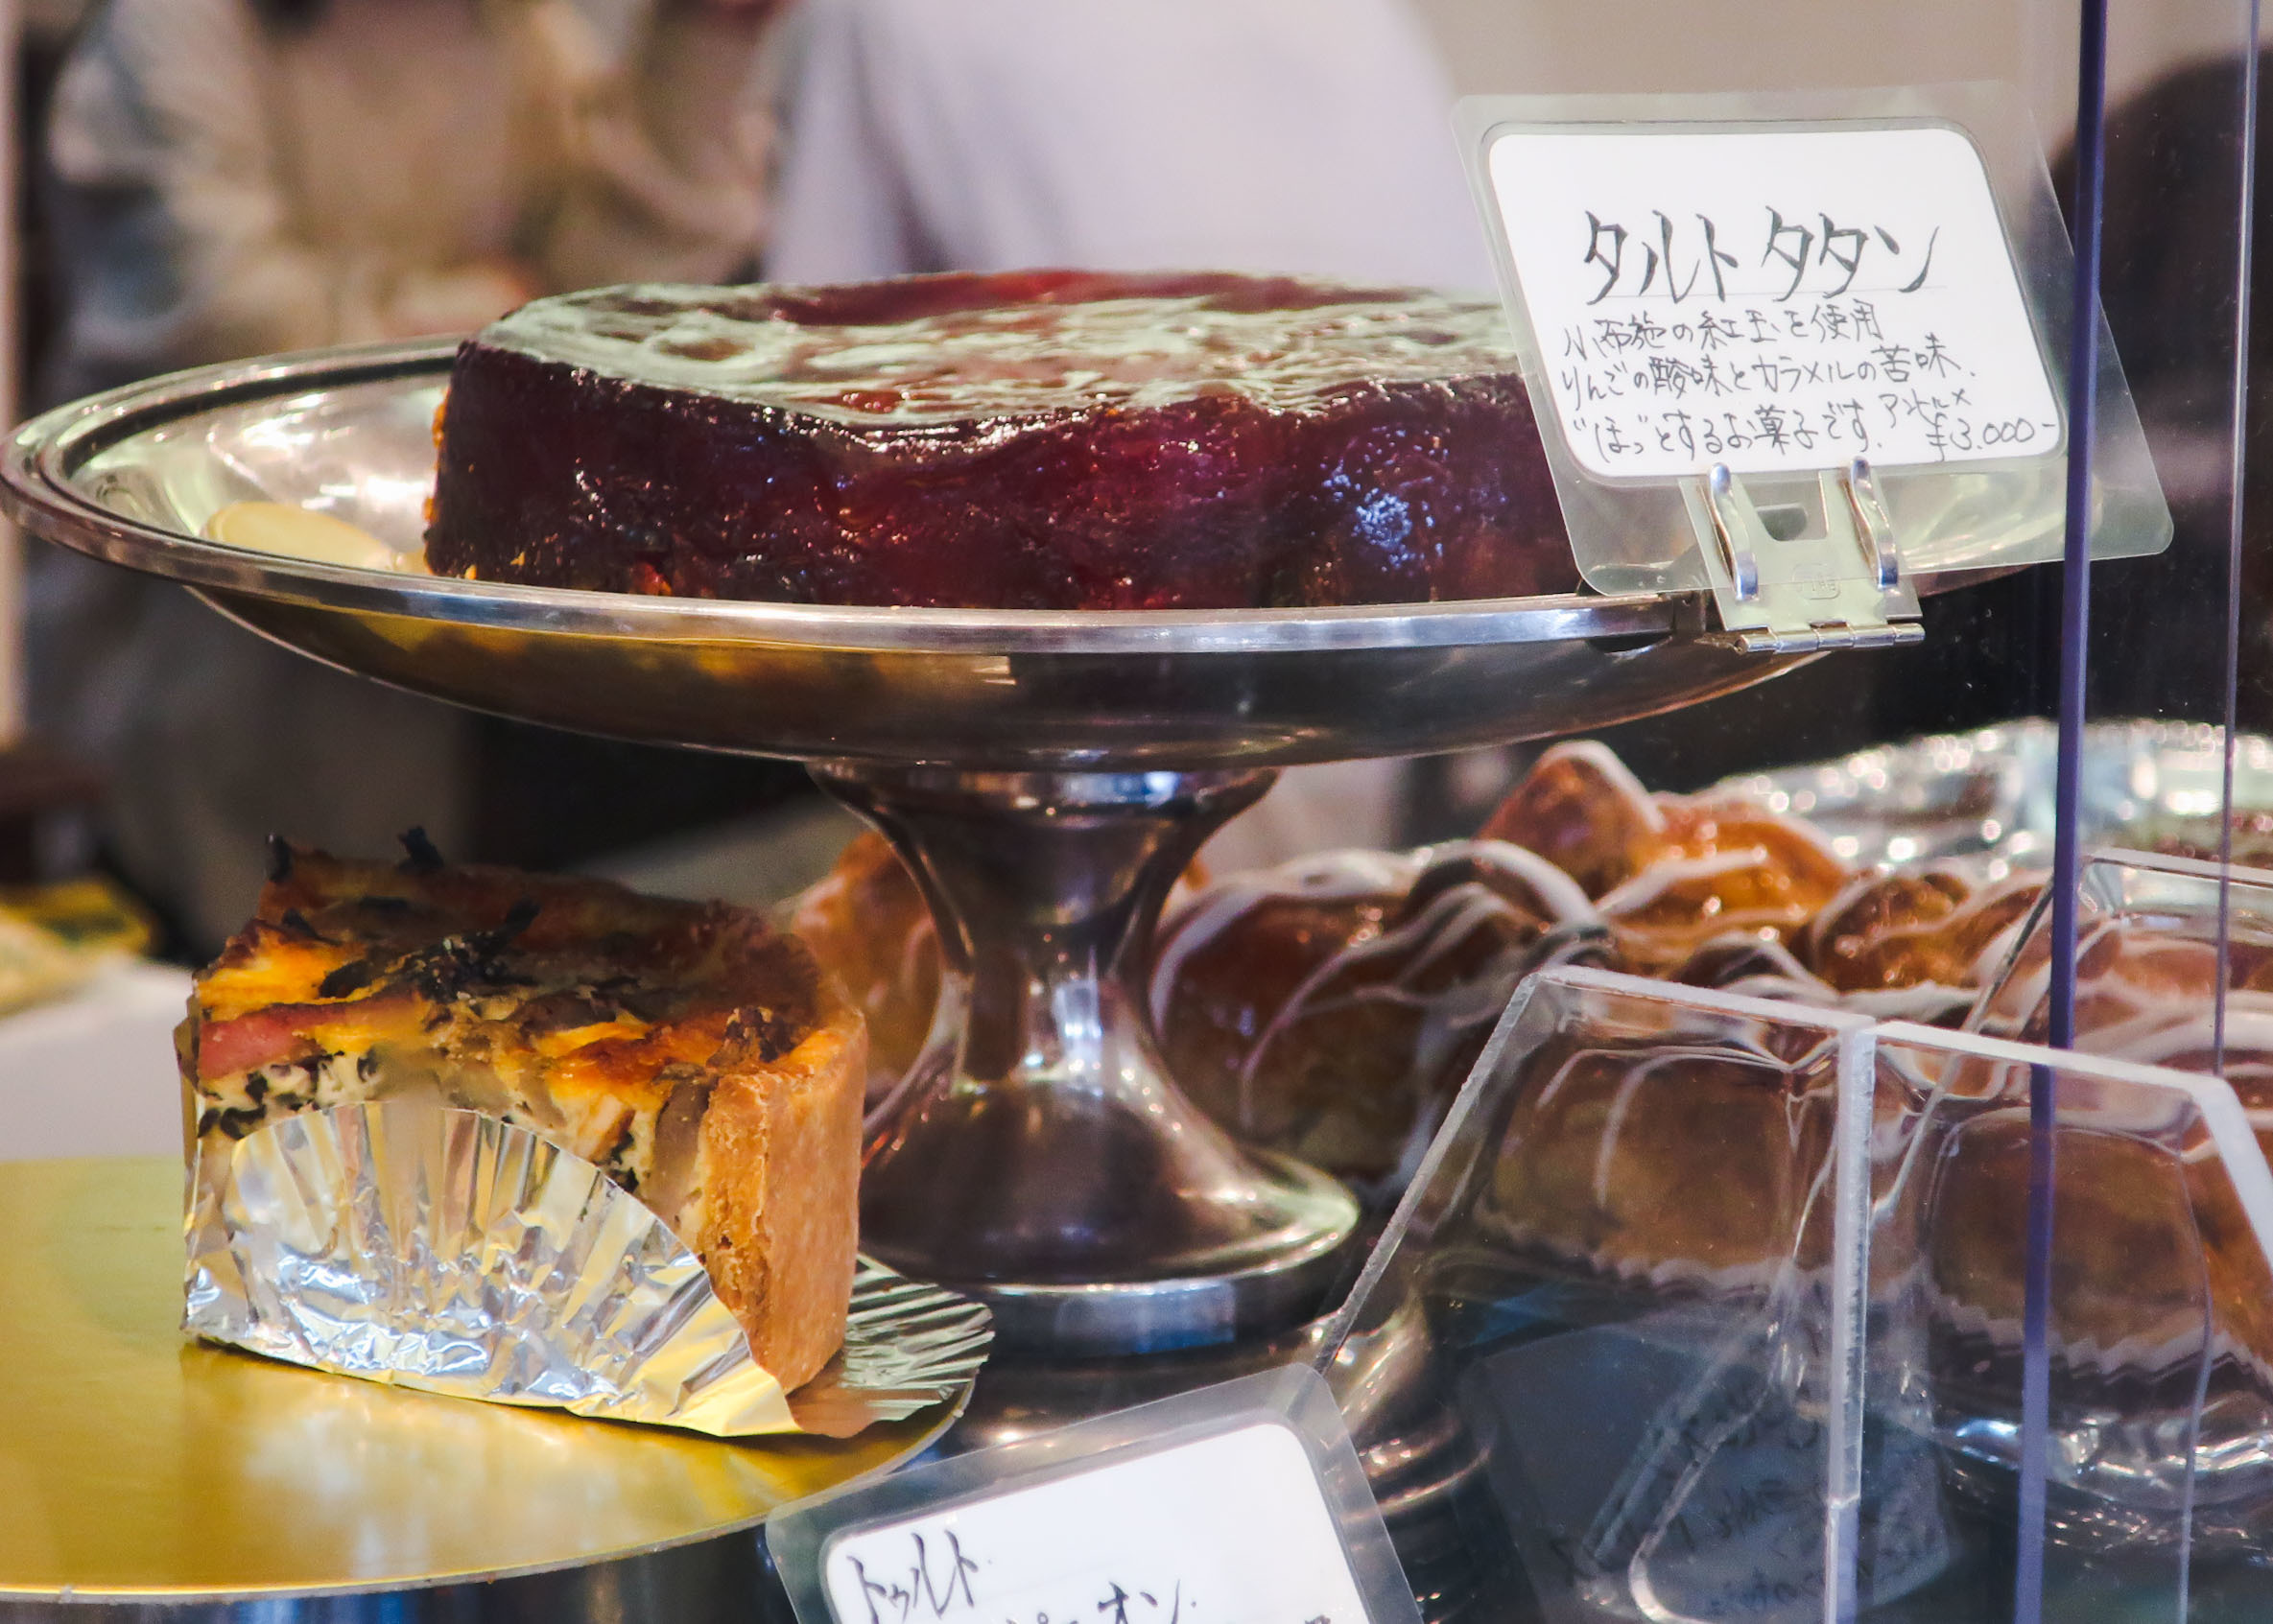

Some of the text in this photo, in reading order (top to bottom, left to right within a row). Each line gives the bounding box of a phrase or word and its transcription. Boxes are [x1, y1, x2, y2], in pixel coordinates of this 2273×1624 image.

[1583, 204, 1940, 305] タルト タタン
[1564, 298, 1883, 361] 小布施の紅玉を使用
